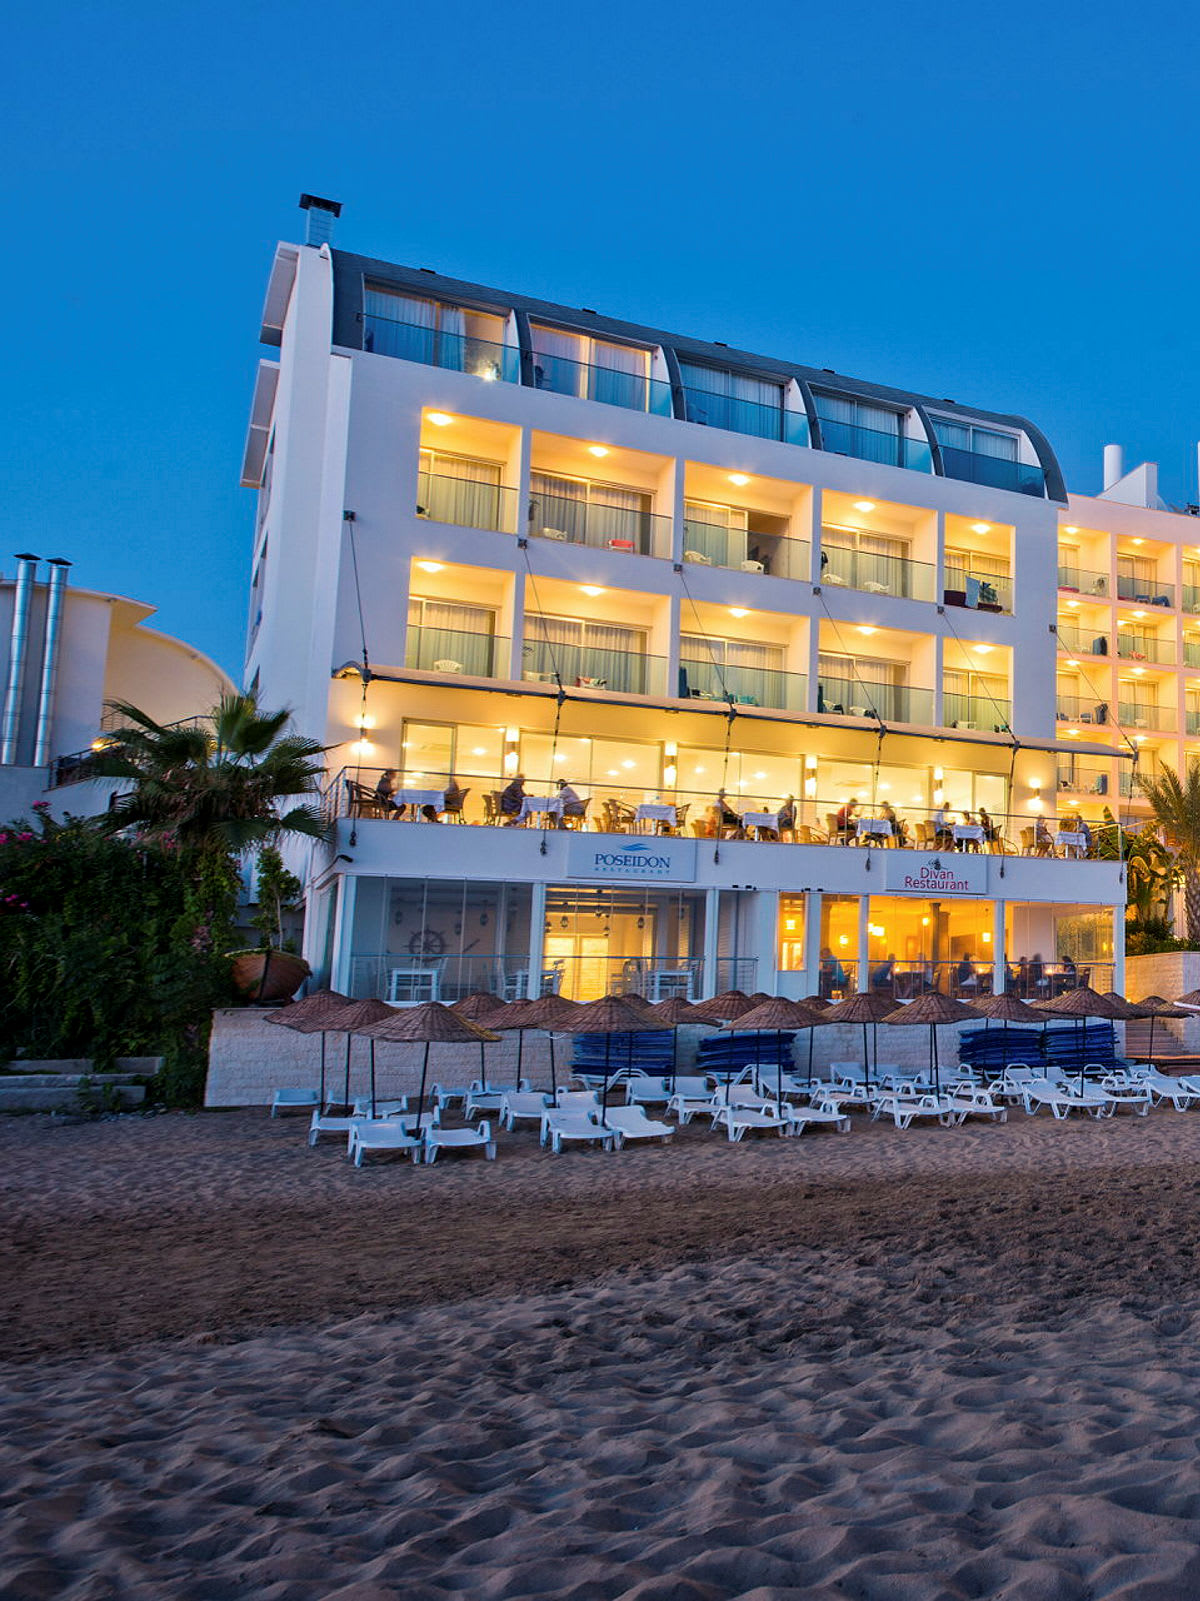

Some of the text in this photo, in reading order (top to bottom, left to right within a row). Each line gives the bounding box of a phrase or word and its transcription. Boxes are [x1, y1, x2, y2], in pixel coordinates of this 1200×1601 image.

[594, 853, 671, 868] POSEIDON
[920, 867, 954, 879] Divan
[904, 876, 969, 890] Restaurant
